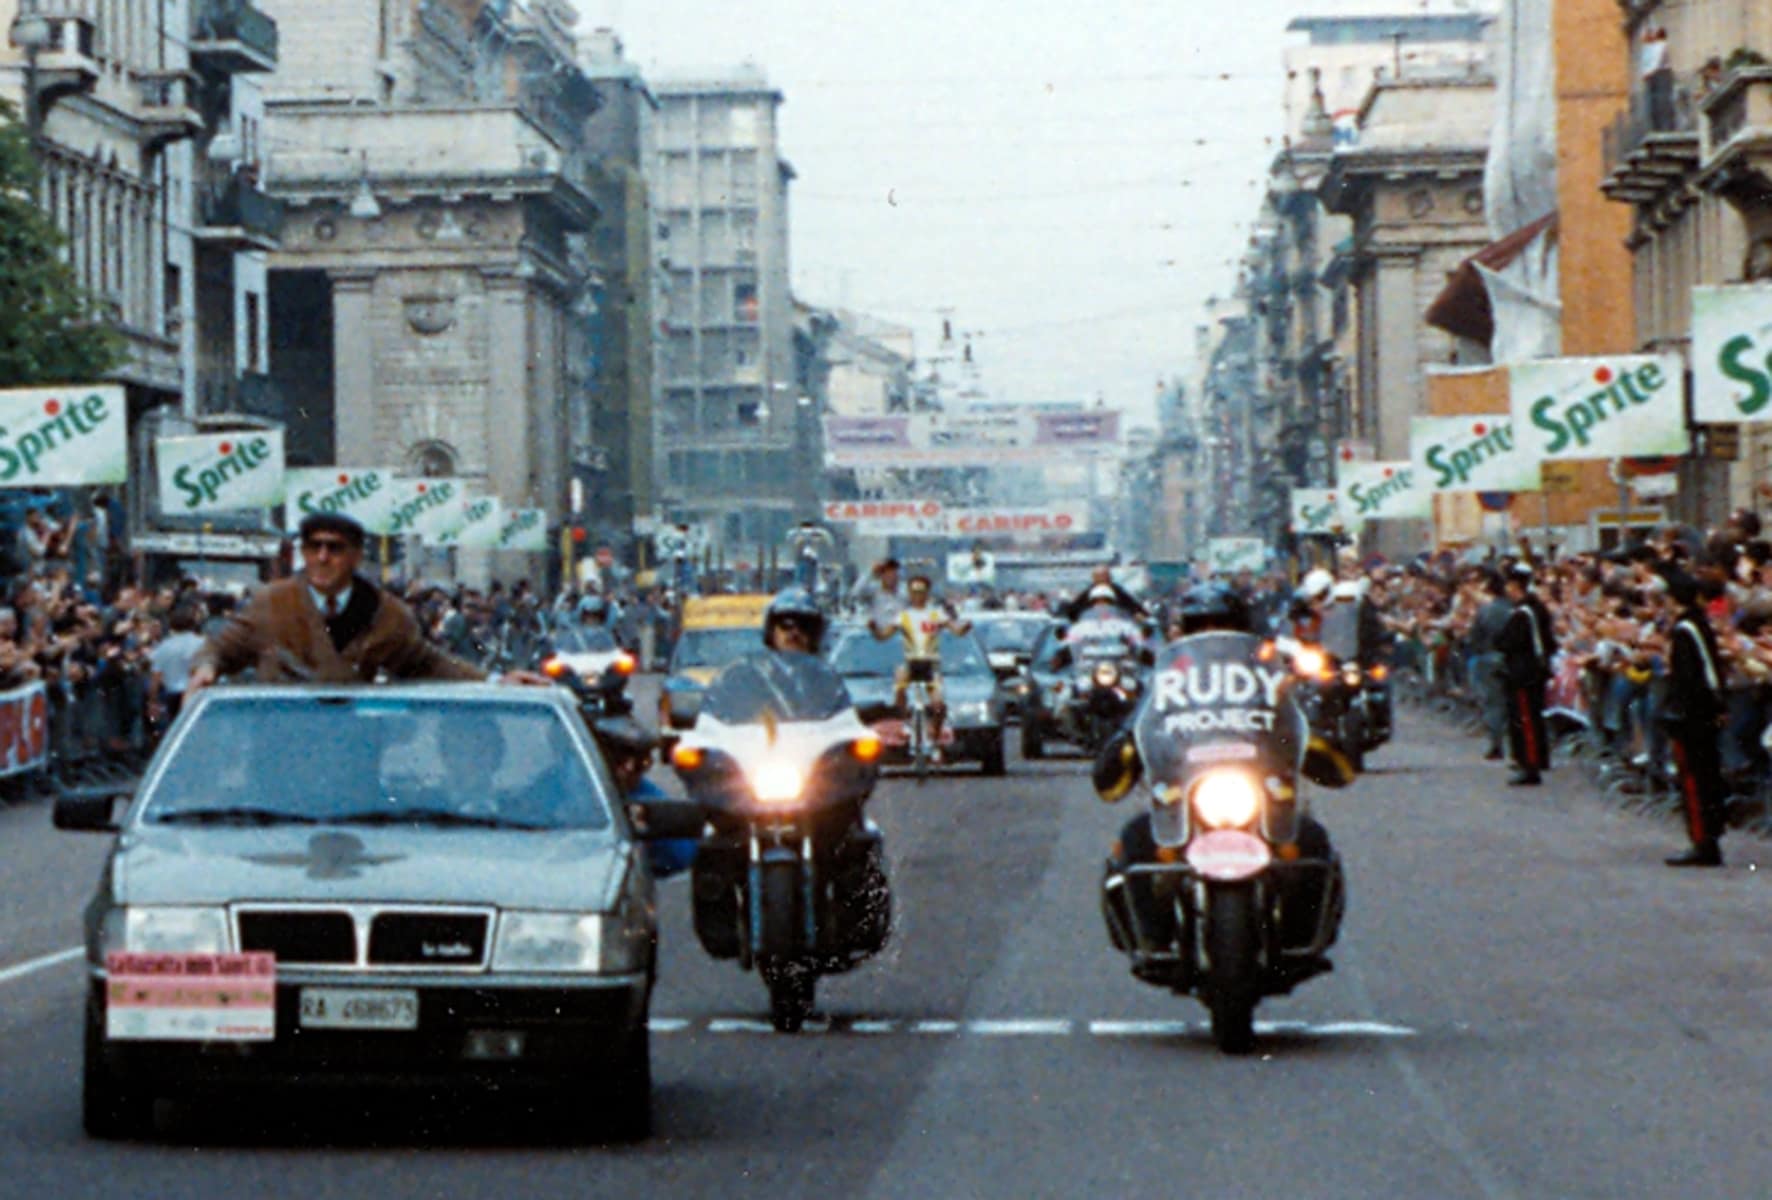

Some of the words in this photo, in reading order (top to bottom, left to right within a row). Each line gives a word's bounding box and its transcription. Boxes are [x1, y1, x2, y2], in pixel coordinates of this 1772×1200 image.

[1530, 361, 1666, 453] Sprite
[173, 438, 270, 508] Sprite
[826, 502, 940, 519] CARIPLO
[957, 513, 1073, 533] CARIPLO
[1154, 661, 1286, 711] RUDY
[1164, 710, 1276, 736] PROJECT
